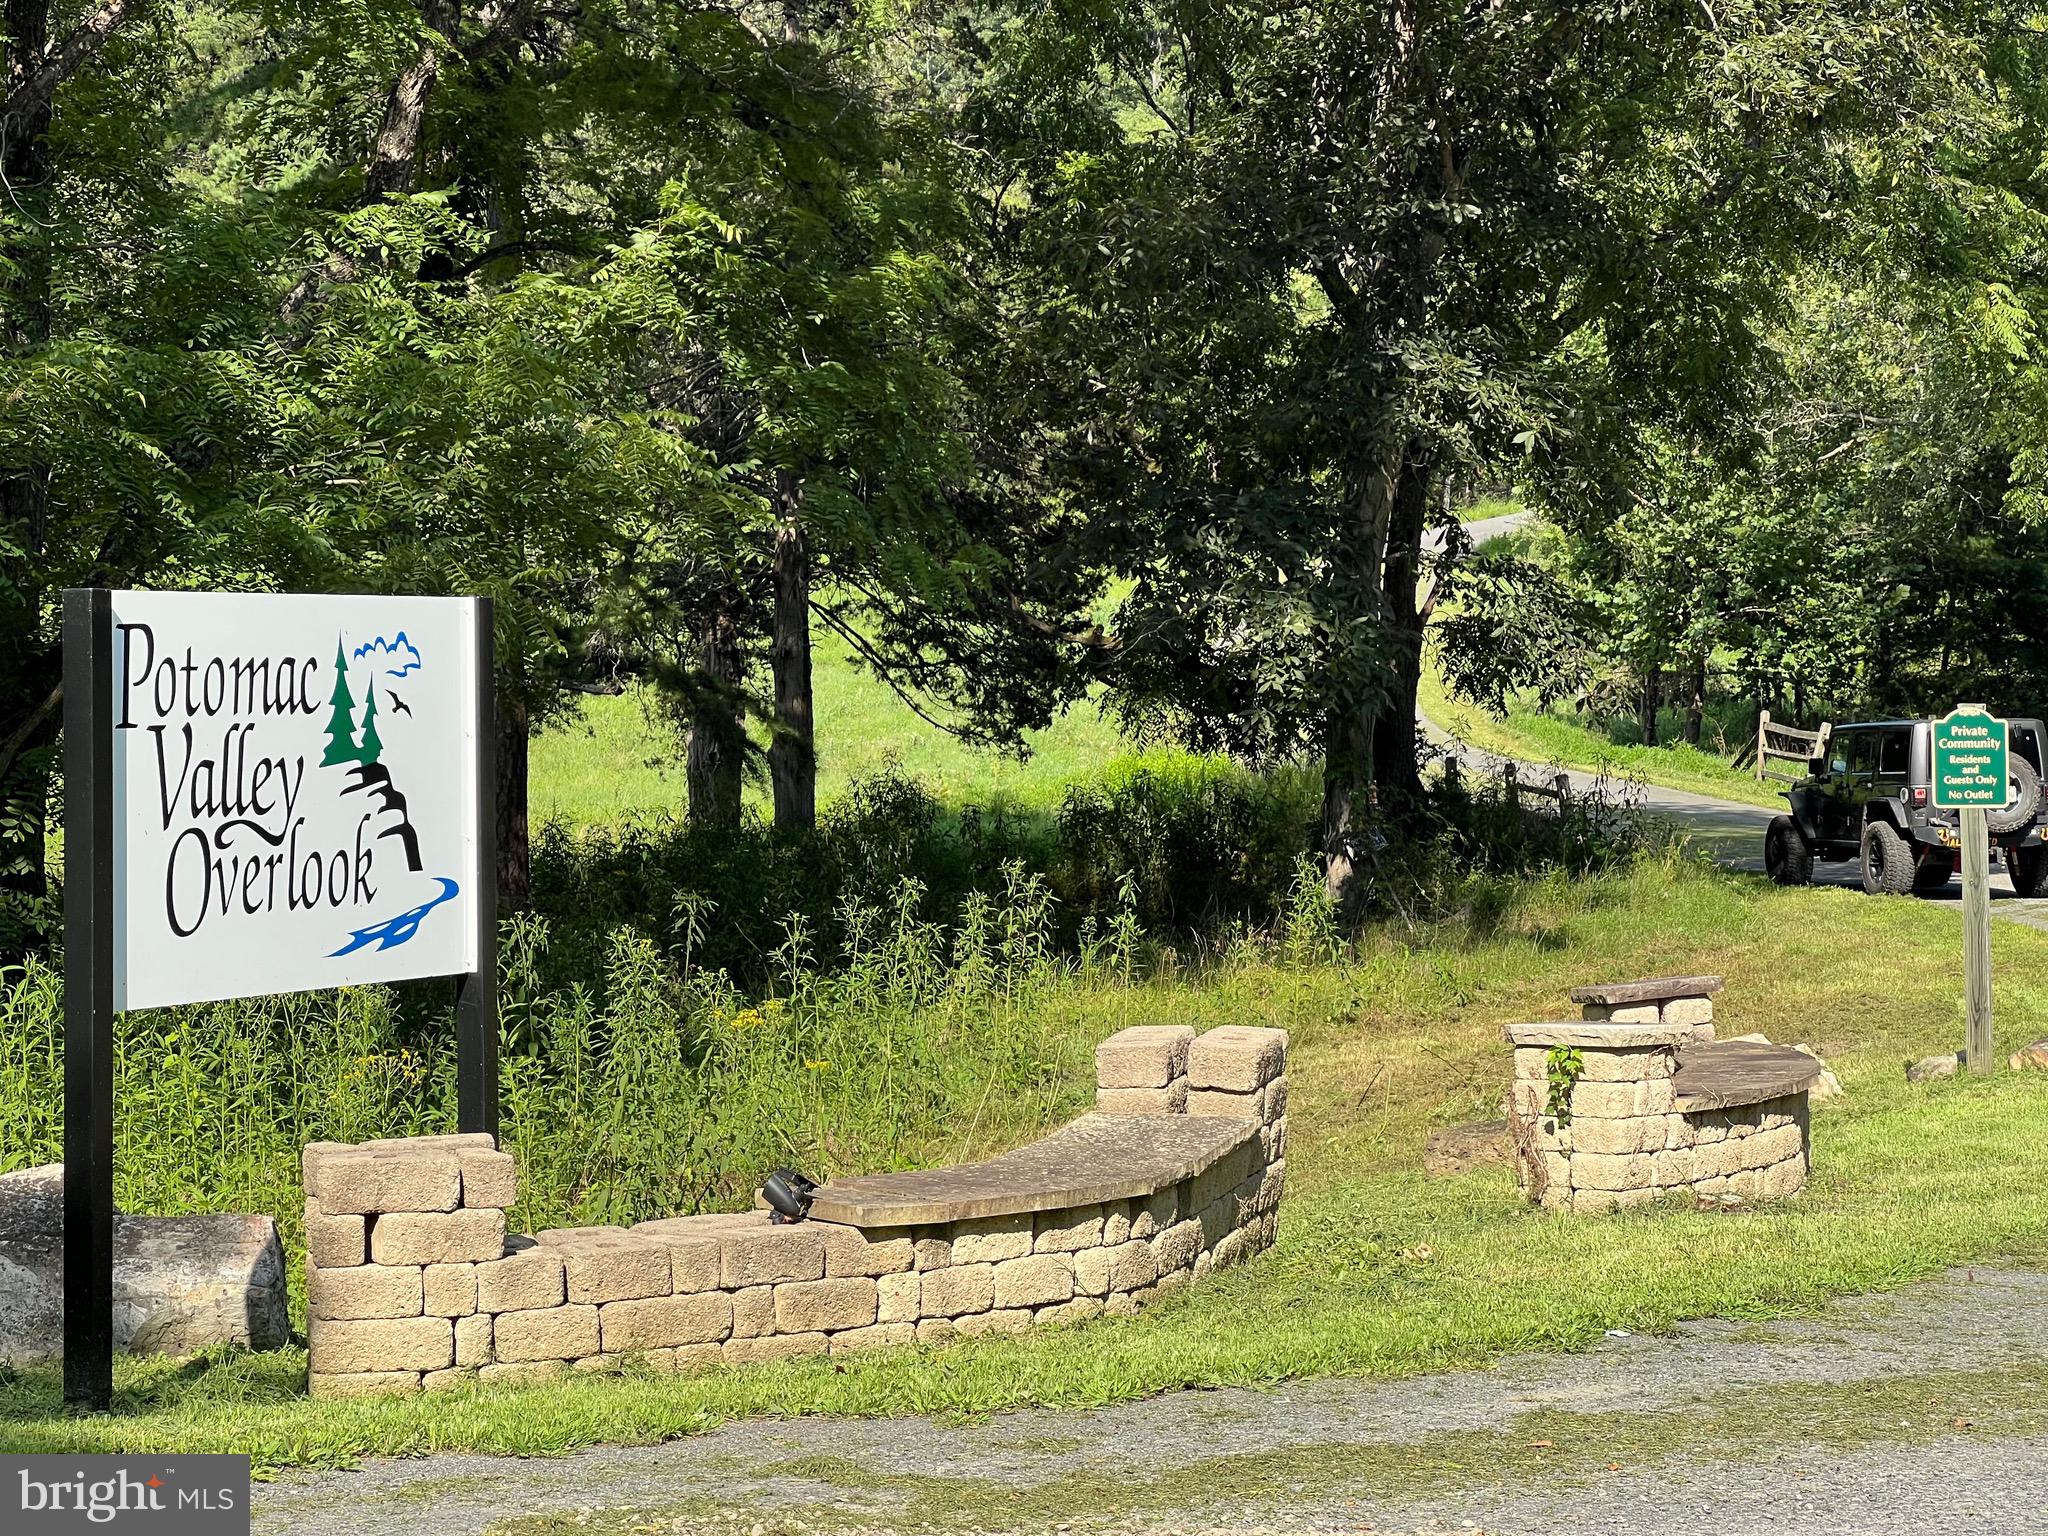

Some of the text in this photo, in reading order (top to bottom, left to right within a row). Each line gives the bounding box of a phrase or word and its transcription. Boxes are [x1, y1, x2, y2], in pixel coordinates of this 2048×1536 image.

[114, 623, 321, 729] Potomac
[1951, 725, 1988, 736] Private
[1938, 737, 2001, 751] Community
[1949, 755, 1991, 764] Residents
[1962, 765, 1979, 774] and
[146, 721, 304, 850] Valley
[1943, 775, 1997, 786] Guests Only
[1948, 790, 1993, 799] No Outlet
[166, 813, 378, 938] Overlook
